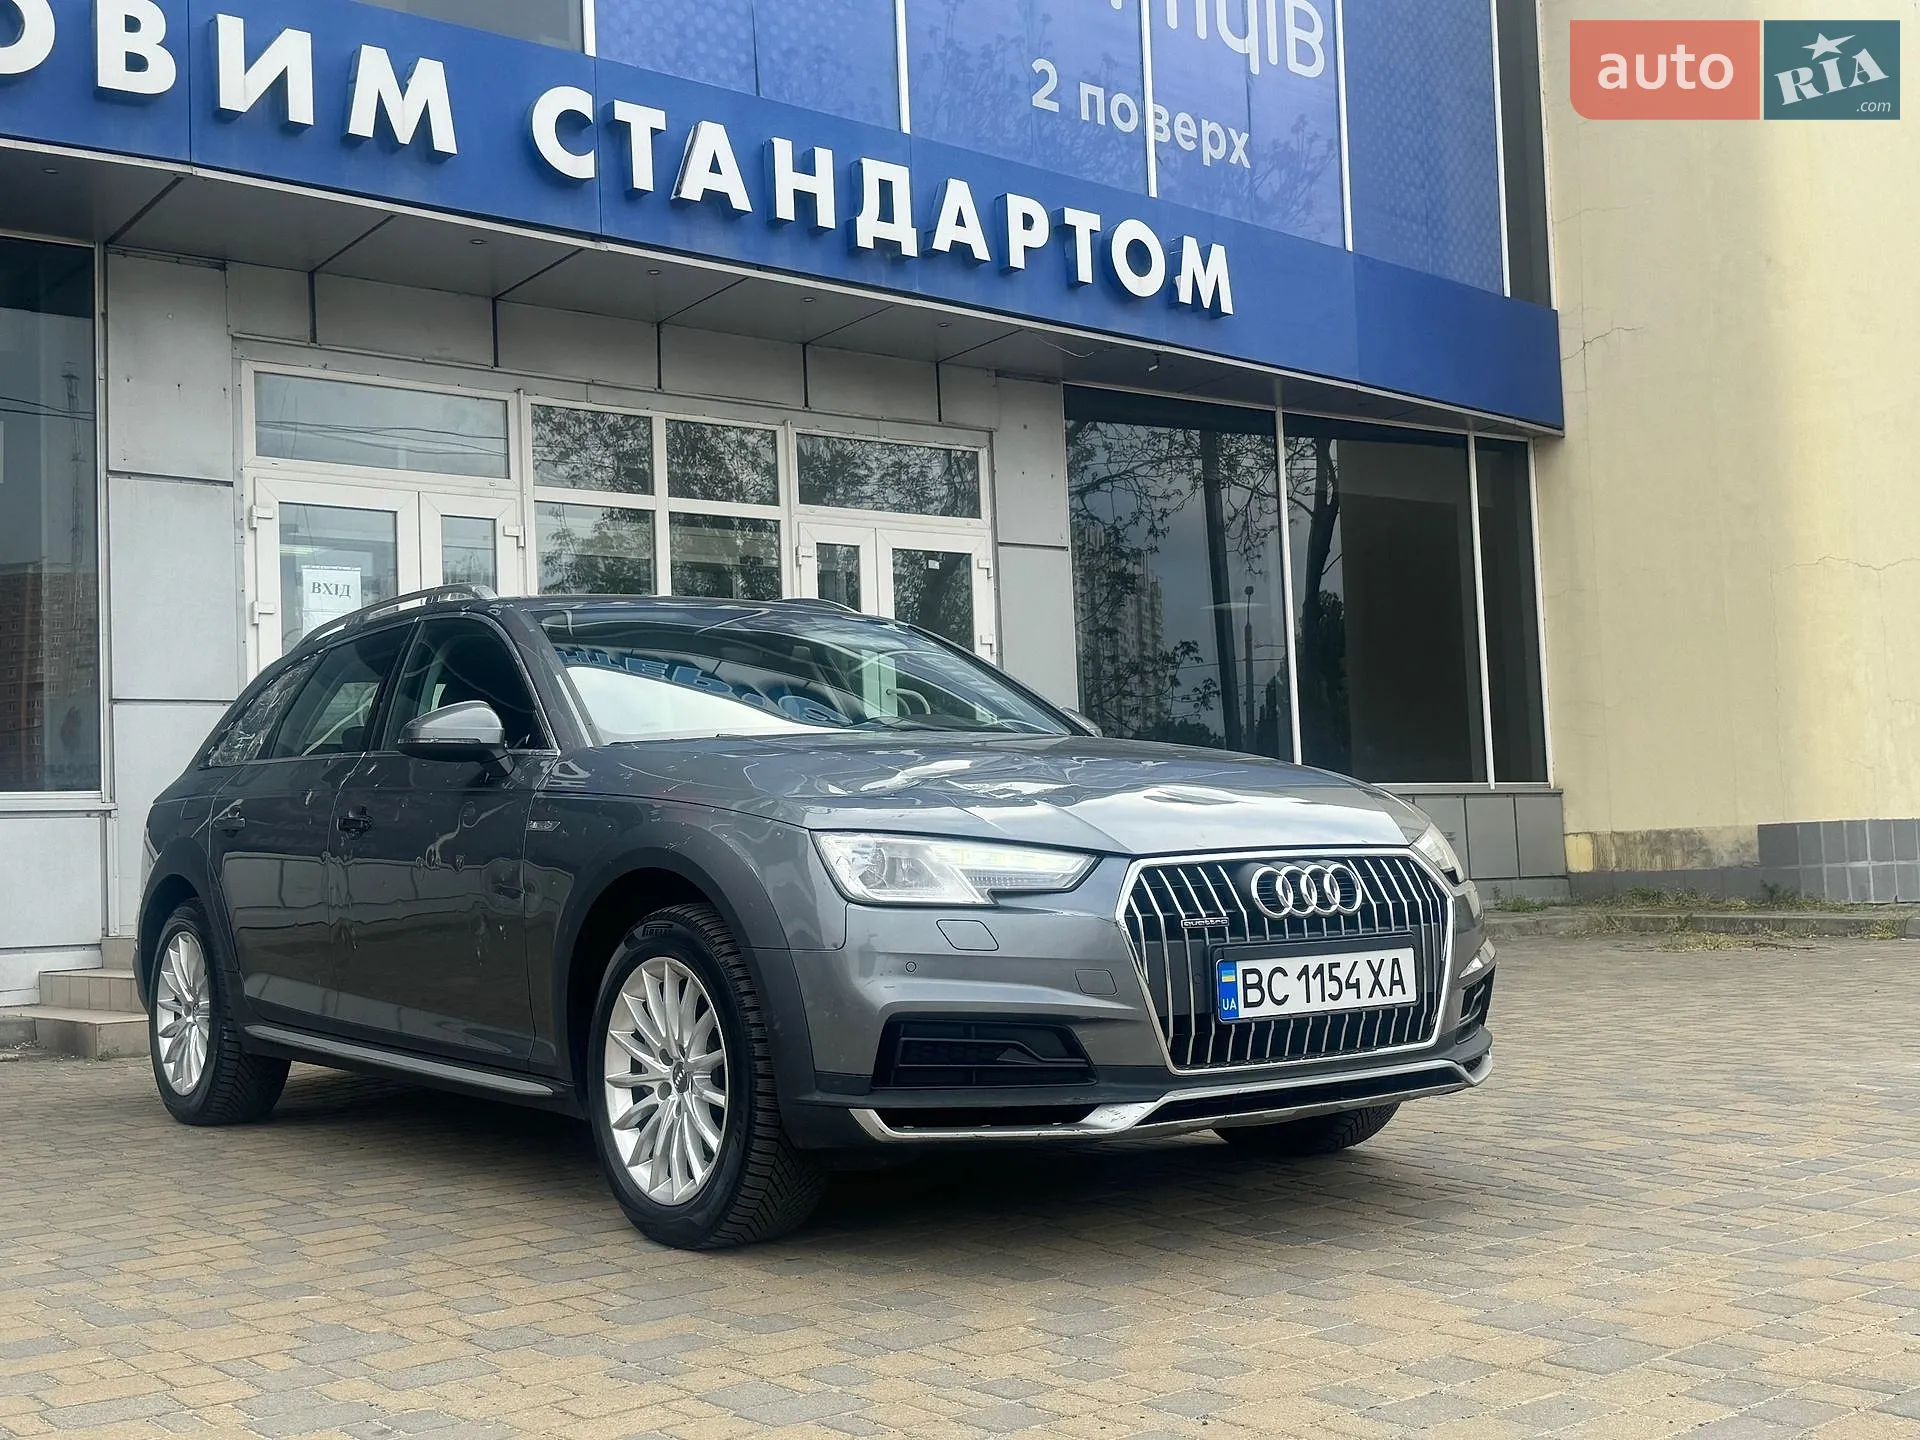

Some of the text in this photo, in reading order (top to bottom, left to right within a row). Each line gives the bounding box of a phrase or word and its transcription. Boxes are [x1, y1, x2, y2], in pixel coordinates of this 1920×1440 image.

[1031, 58, 1251, 169] 2 поверх
[530, 86, 1233, 316] СТАНДАРТОМ
[311, 582, 352, 598] ВХІД
[1183, 919, 1228, 927] quattro
[1222, 998, 1238, 1011] UA
